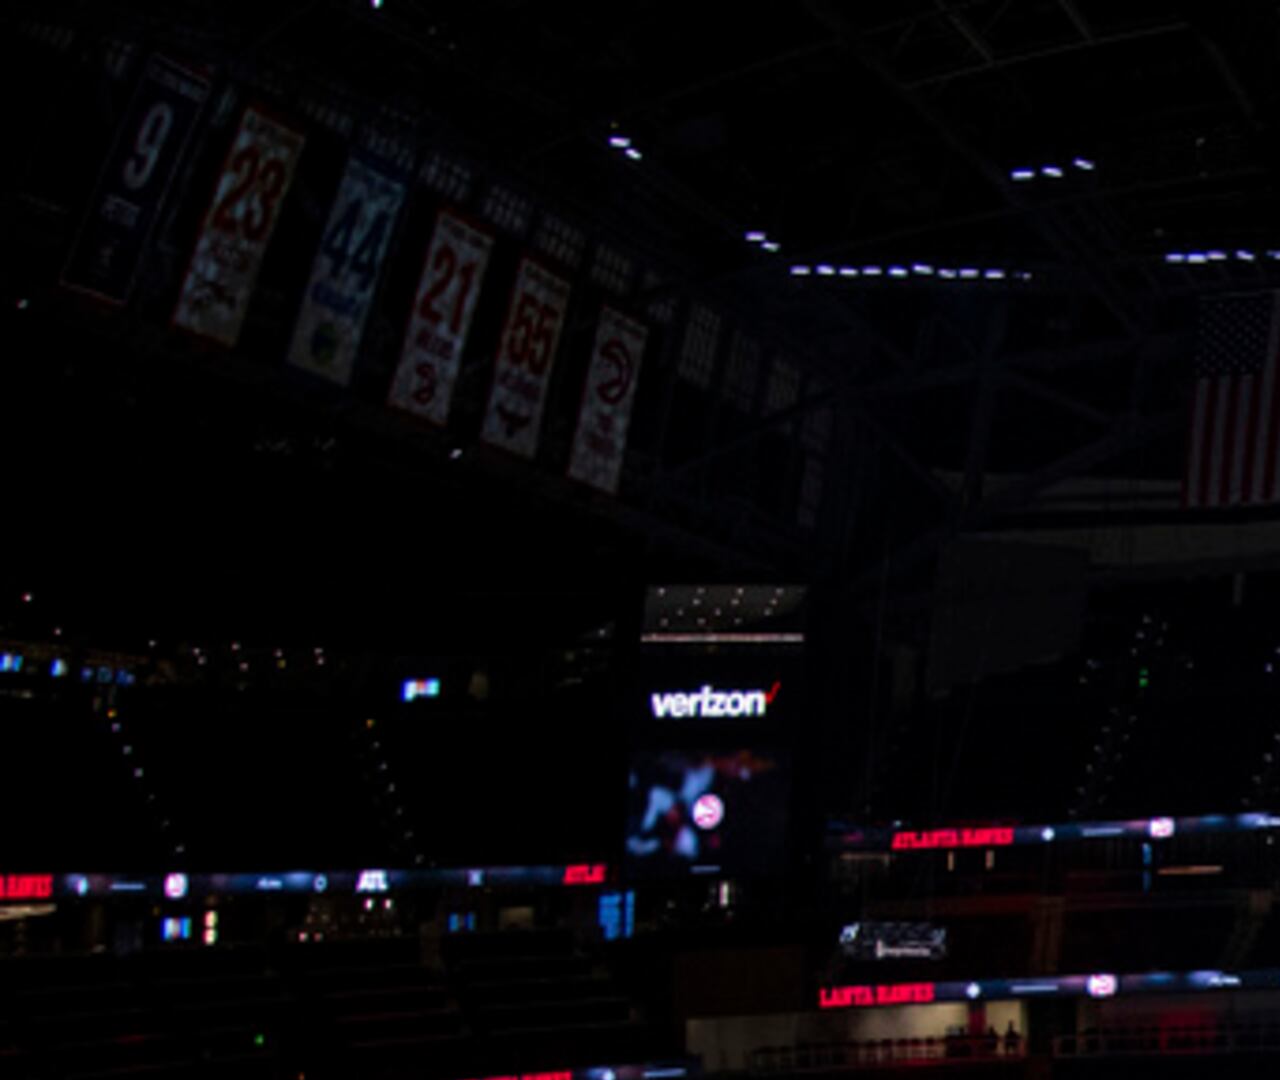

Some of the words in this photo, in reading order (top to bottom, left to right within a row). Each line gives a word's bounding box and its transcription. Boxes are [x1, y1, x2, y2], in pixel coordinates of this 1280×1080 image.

[120, 101, 175, 189] 9
[210, 148, 284, 240] 23
[322, 197, 402, 284] 44
[421, 248, 475, 332] 21
[508, 295, 558, 376] 55
[650, 685, 767, 718] verizon
[891, 831, 958, 850] ATLANTA
[961, 826, 1014, 846] HAWKS
[354, 869, 390, 891] ATL
[877, 982, 935, 1004] HAWKS
